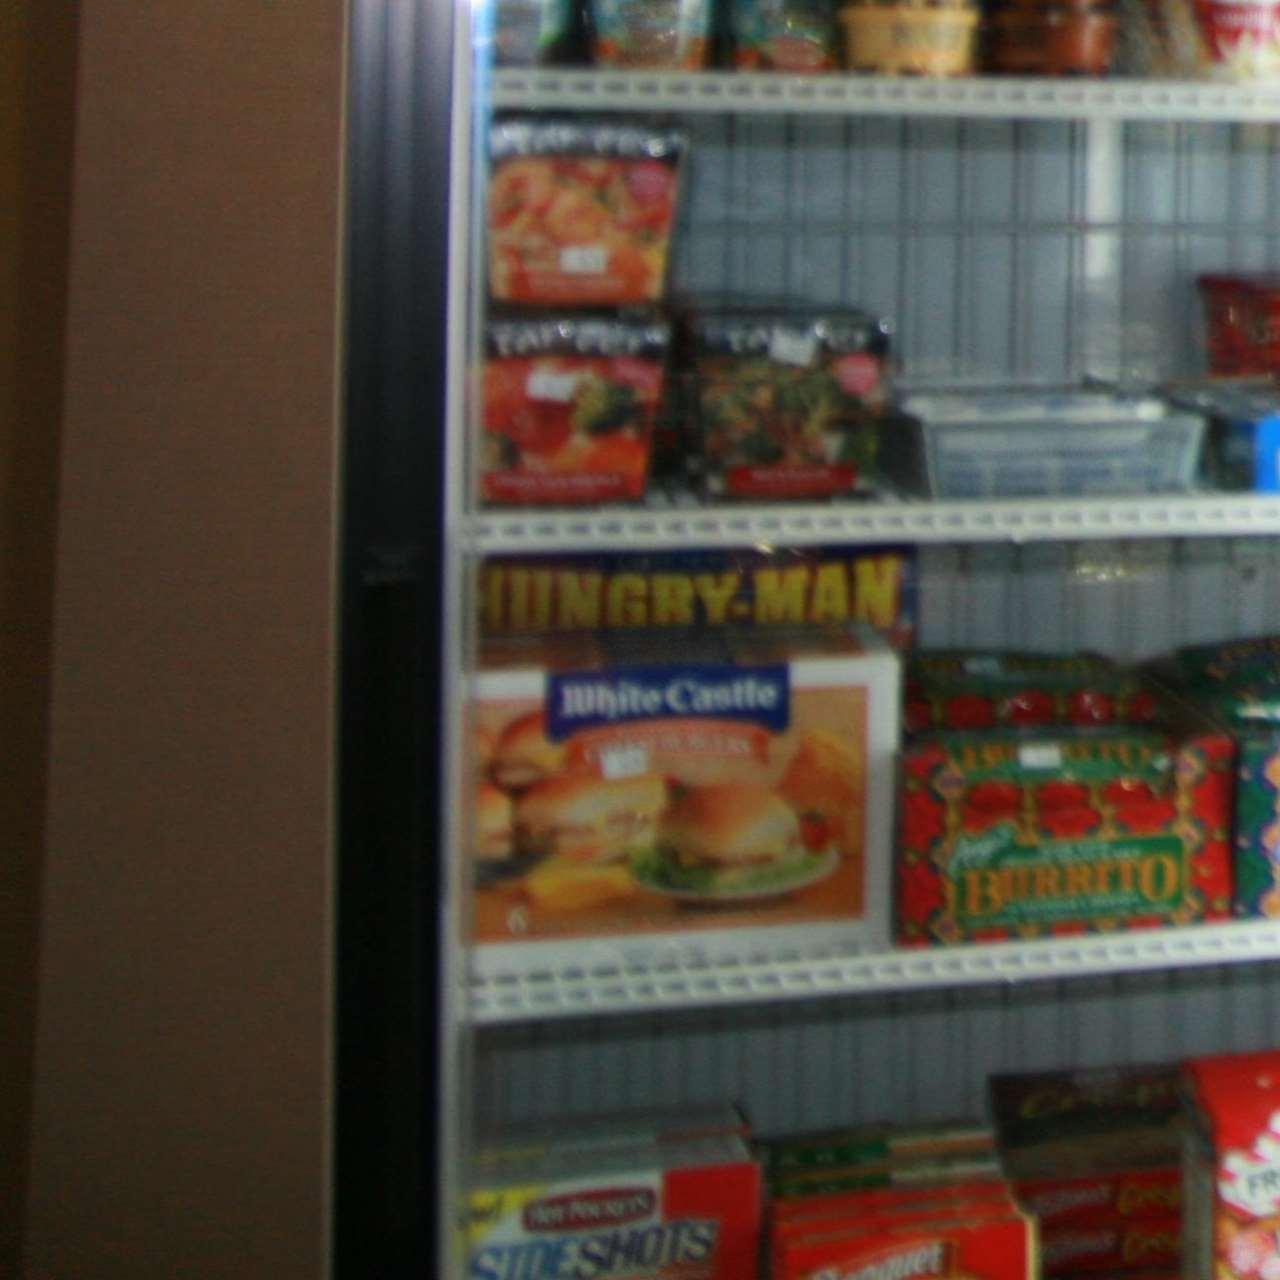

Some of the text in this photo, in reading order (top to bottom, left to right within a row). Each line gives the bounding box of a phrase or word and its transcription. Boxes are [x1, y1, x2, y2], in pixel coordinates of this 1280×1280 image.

[563, 676, 778, 719] White Castle
[965, 852, 1180, 916] BURRITO
